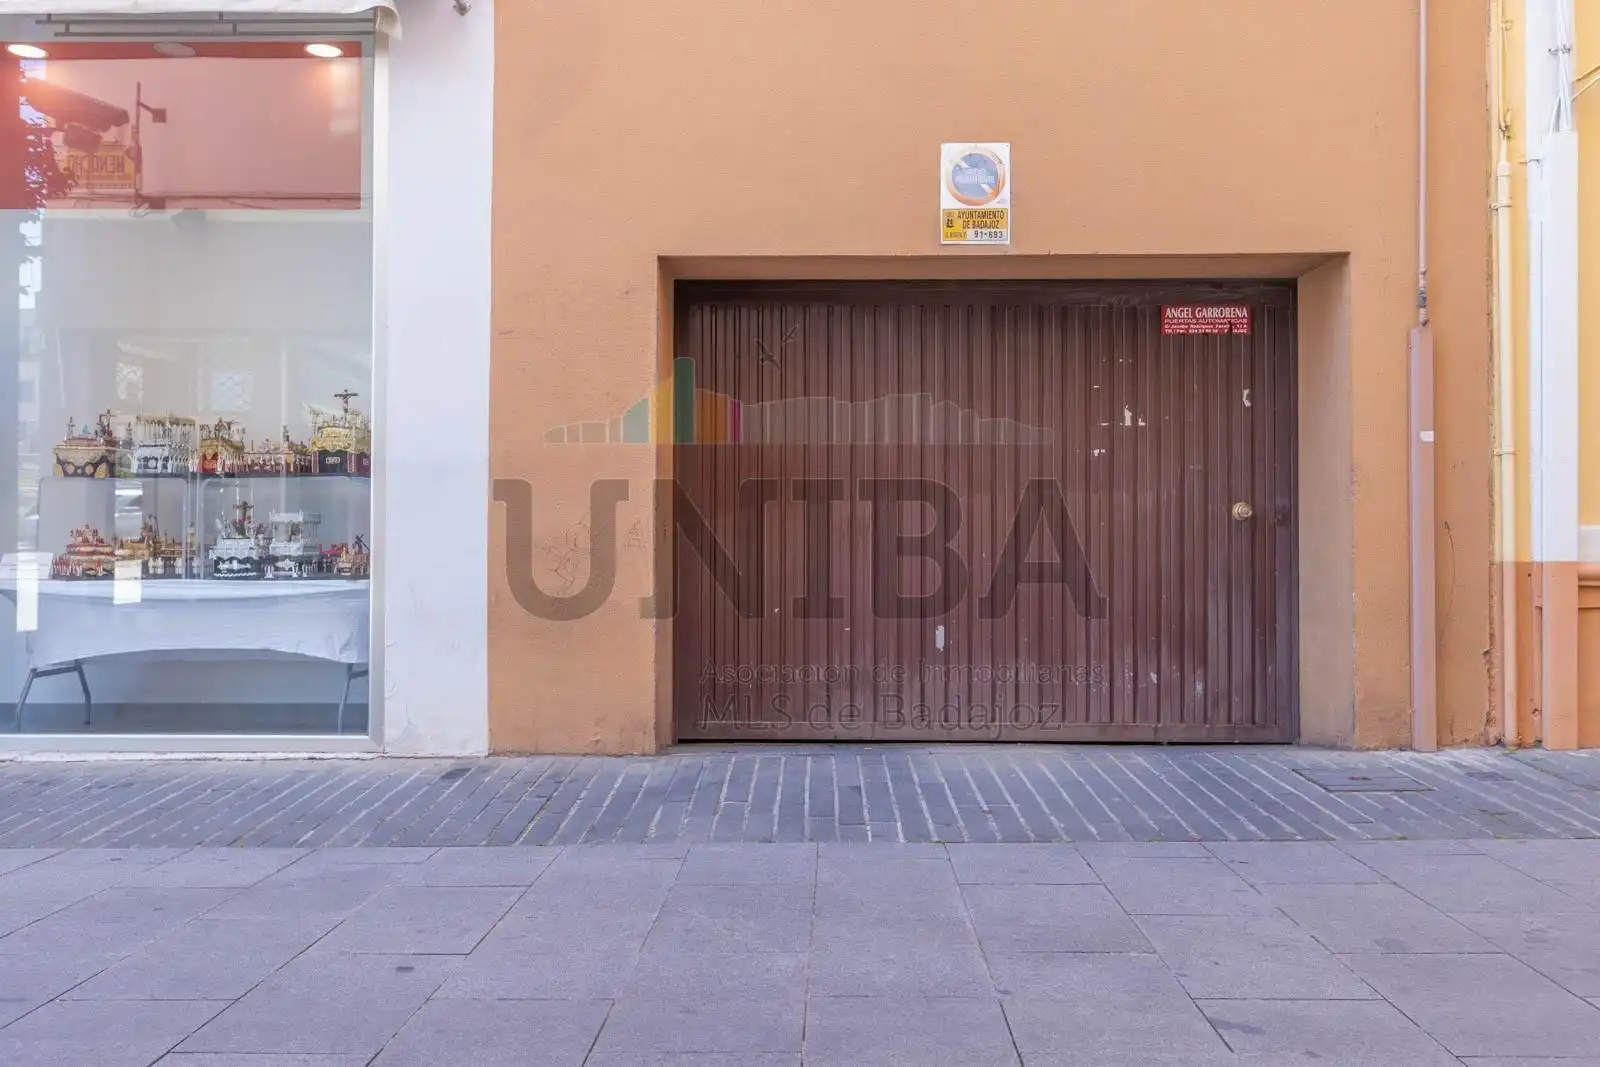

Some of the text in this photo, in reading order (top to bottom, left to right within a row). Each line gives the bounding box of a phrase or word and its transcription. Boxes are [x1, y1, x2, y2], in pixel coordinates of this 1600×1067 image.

[957, 210, 1004, 220] AYUNTAMIENTO
[962, 220, 1000, 229] DE BADAJOZ
[1165, 307, 1248, 318] ANGEL GARRORENA
